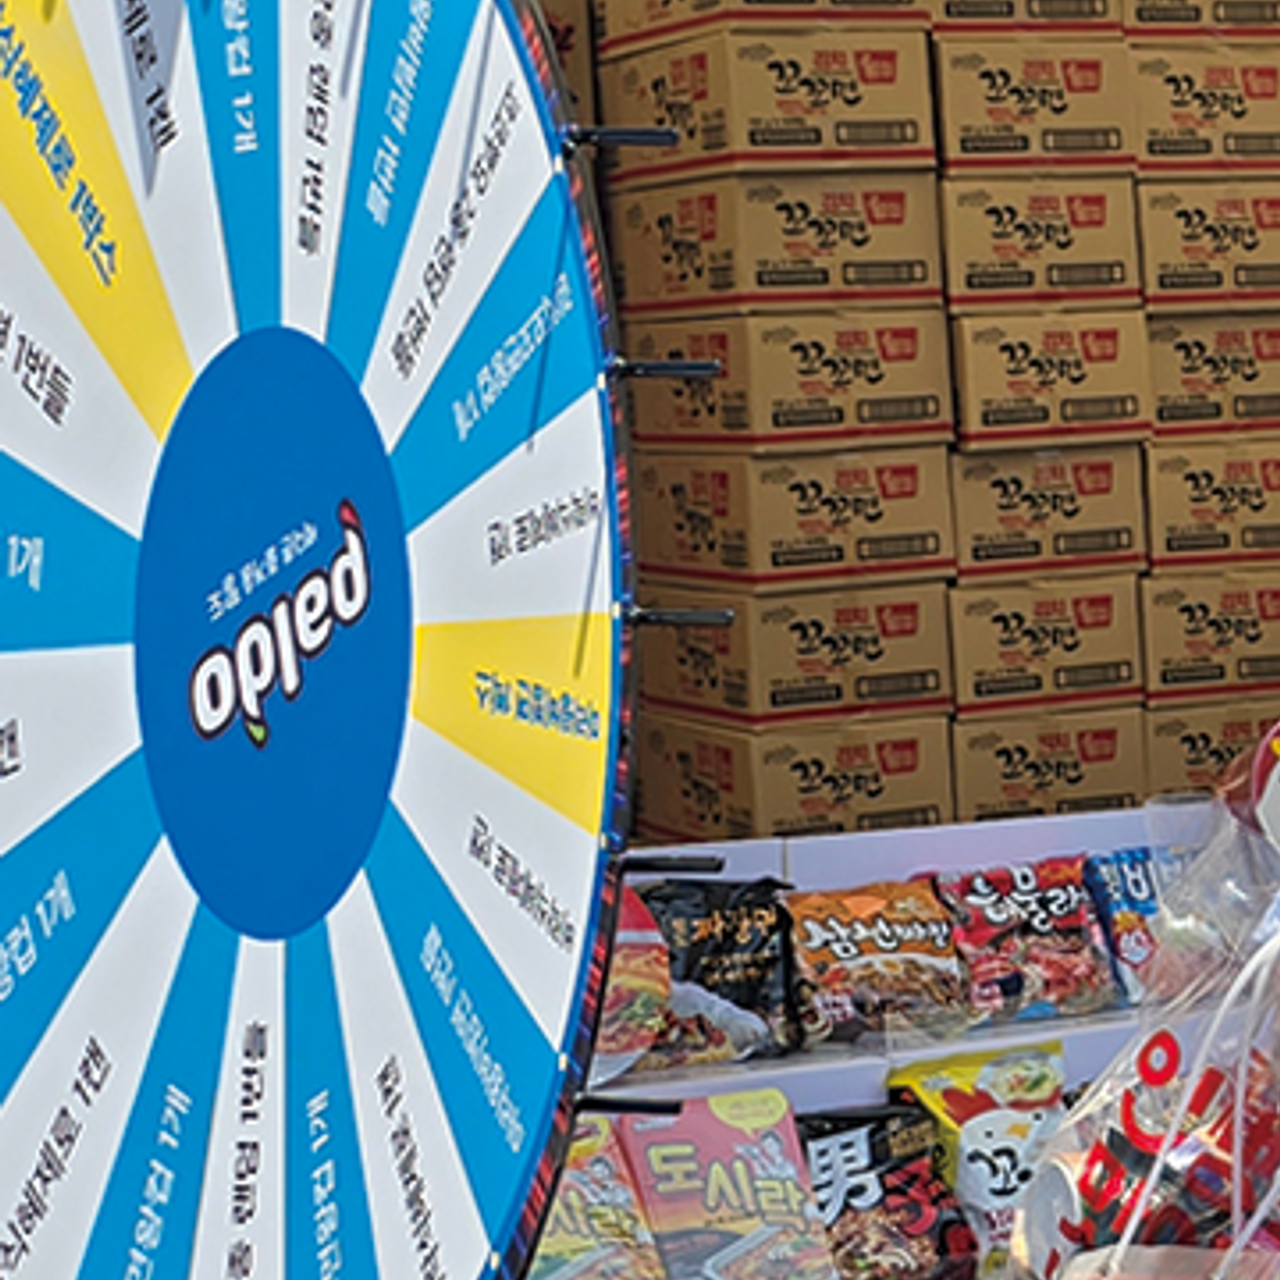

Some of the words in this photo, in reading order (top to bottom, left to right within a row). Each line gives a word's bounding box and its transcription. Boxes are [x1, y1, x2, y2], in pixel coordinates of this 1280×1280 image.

[0, 0, 74, 187] 식혜제로
[189, 498, 370, 749] paldo
[0, 1107, 80, 1280] 식혜제로
